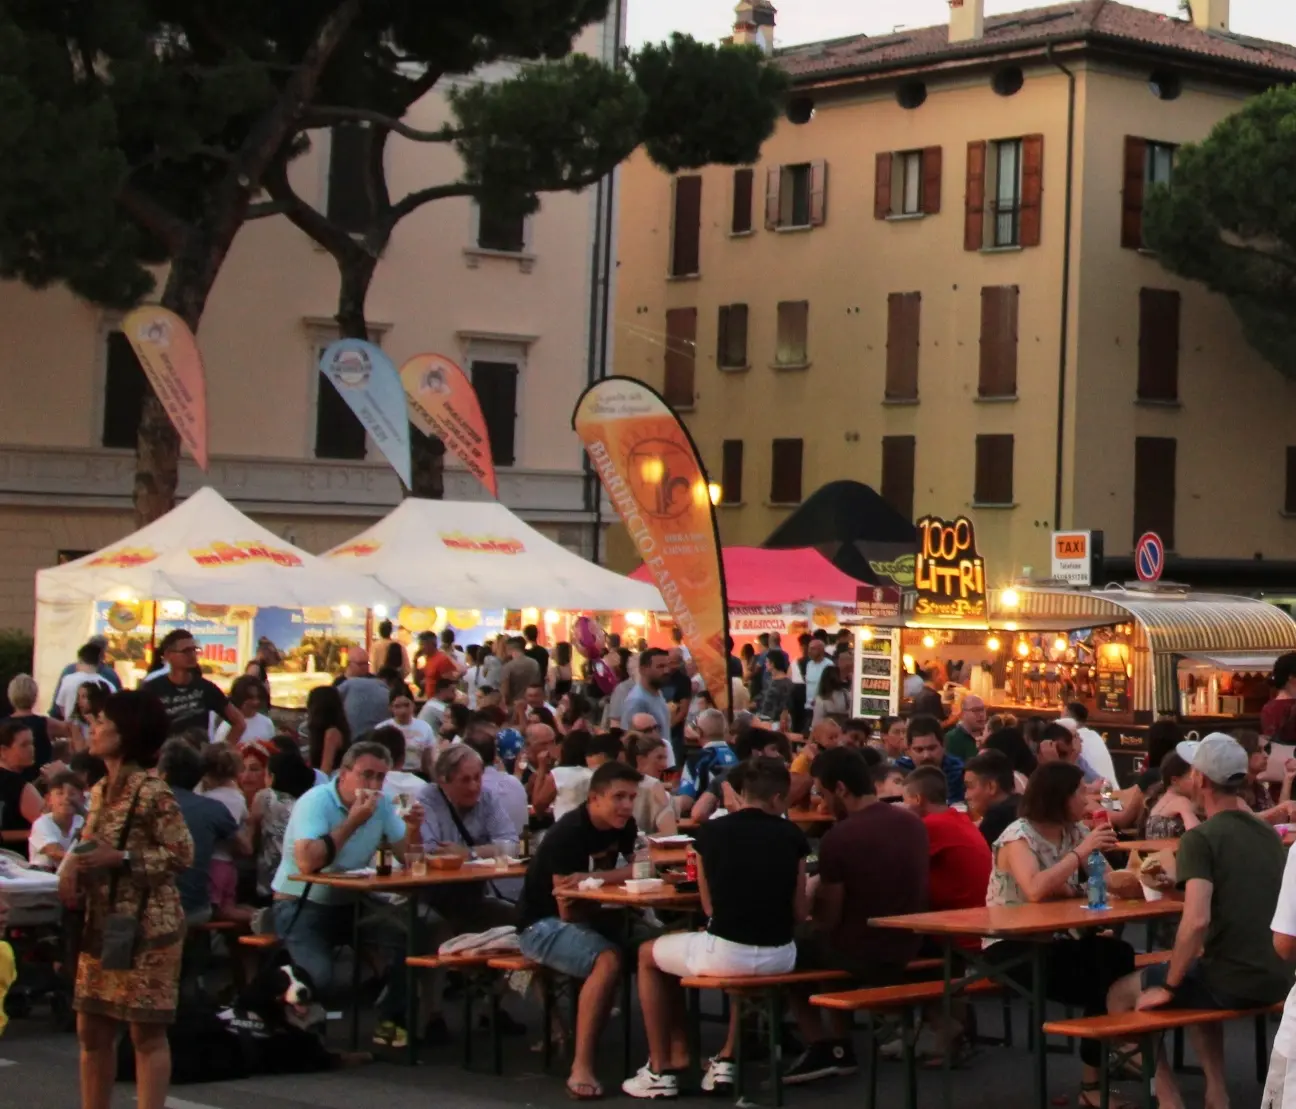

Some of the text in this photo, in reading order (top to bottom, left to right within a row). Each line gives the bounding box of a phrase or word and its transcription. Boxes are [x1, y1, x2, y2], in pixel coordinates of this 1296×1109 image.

[589, 439, 656, 554] BIRRIFICIO
[919, 517, 971, 560] 1000
[1057, 541, 1085, 554] TAXI
[742, 619, 787, 631] SALSICCIA
